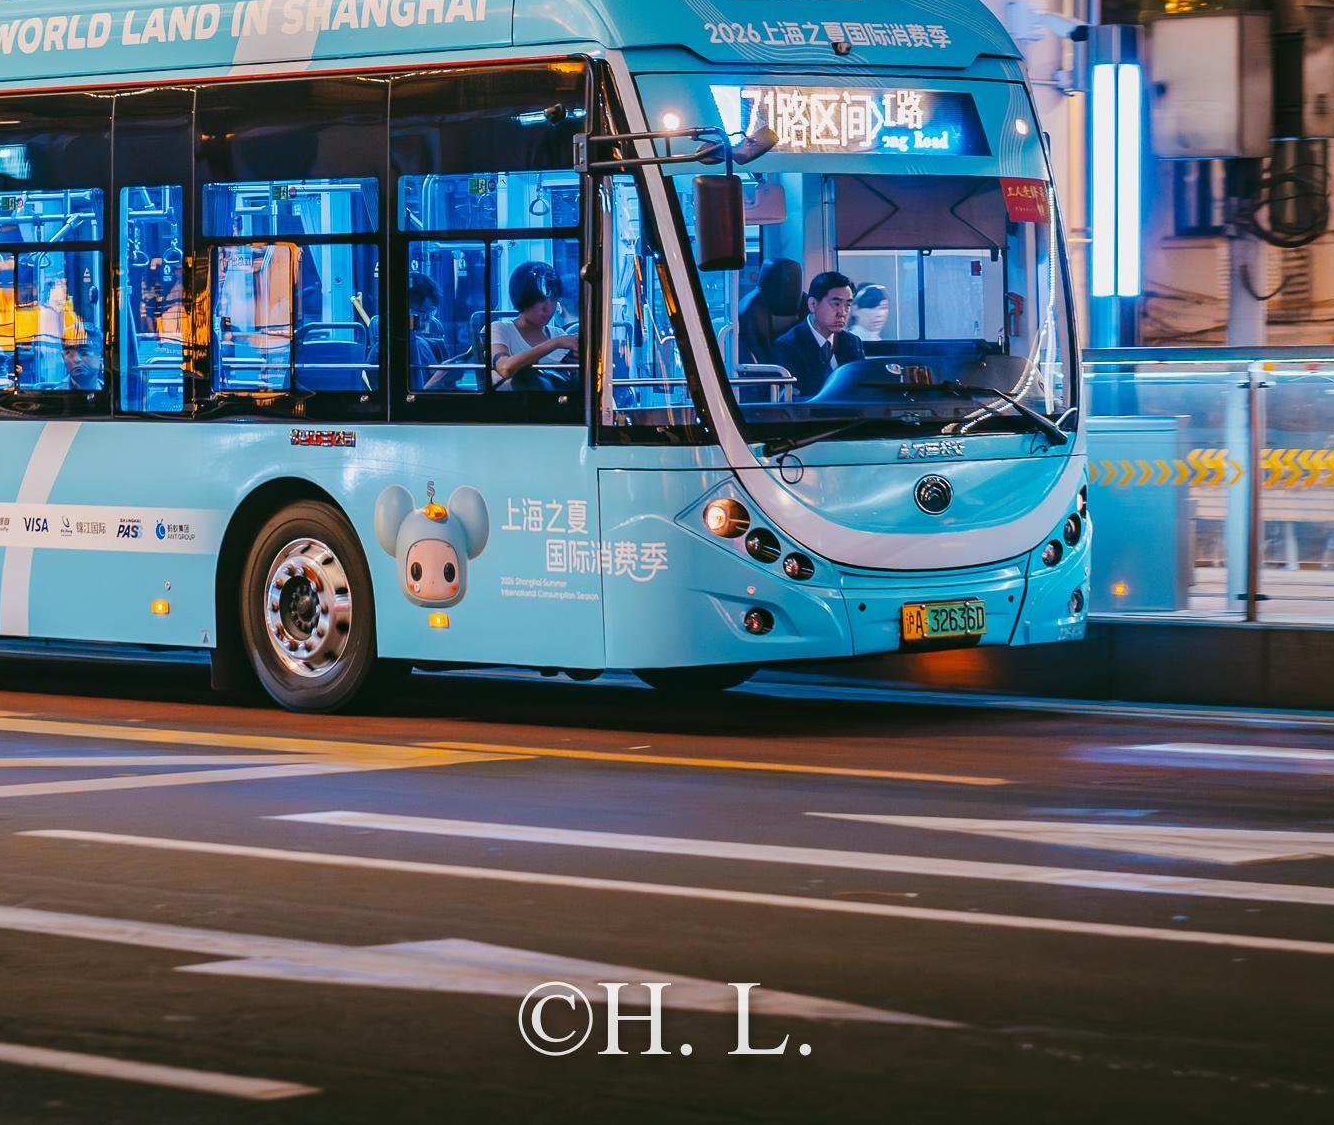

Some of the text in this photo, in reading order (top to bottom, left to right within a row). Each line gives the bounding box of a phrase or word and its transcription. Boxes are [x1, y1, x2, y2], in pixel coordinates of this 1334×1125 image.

[121, 2, 222, 46] LAND
[231, 0, 271, 37] IN
[704, 20, 952, 49] 2026上海之夏国际消费季
[913, 131, 950, 150] Road
[23, 517, 49, 533] VISA
[501, 497, 589, 535] 上海之夏
[545, 539, 669, 582] 国际消费季
[930, 606, 985, 633] 32636D
